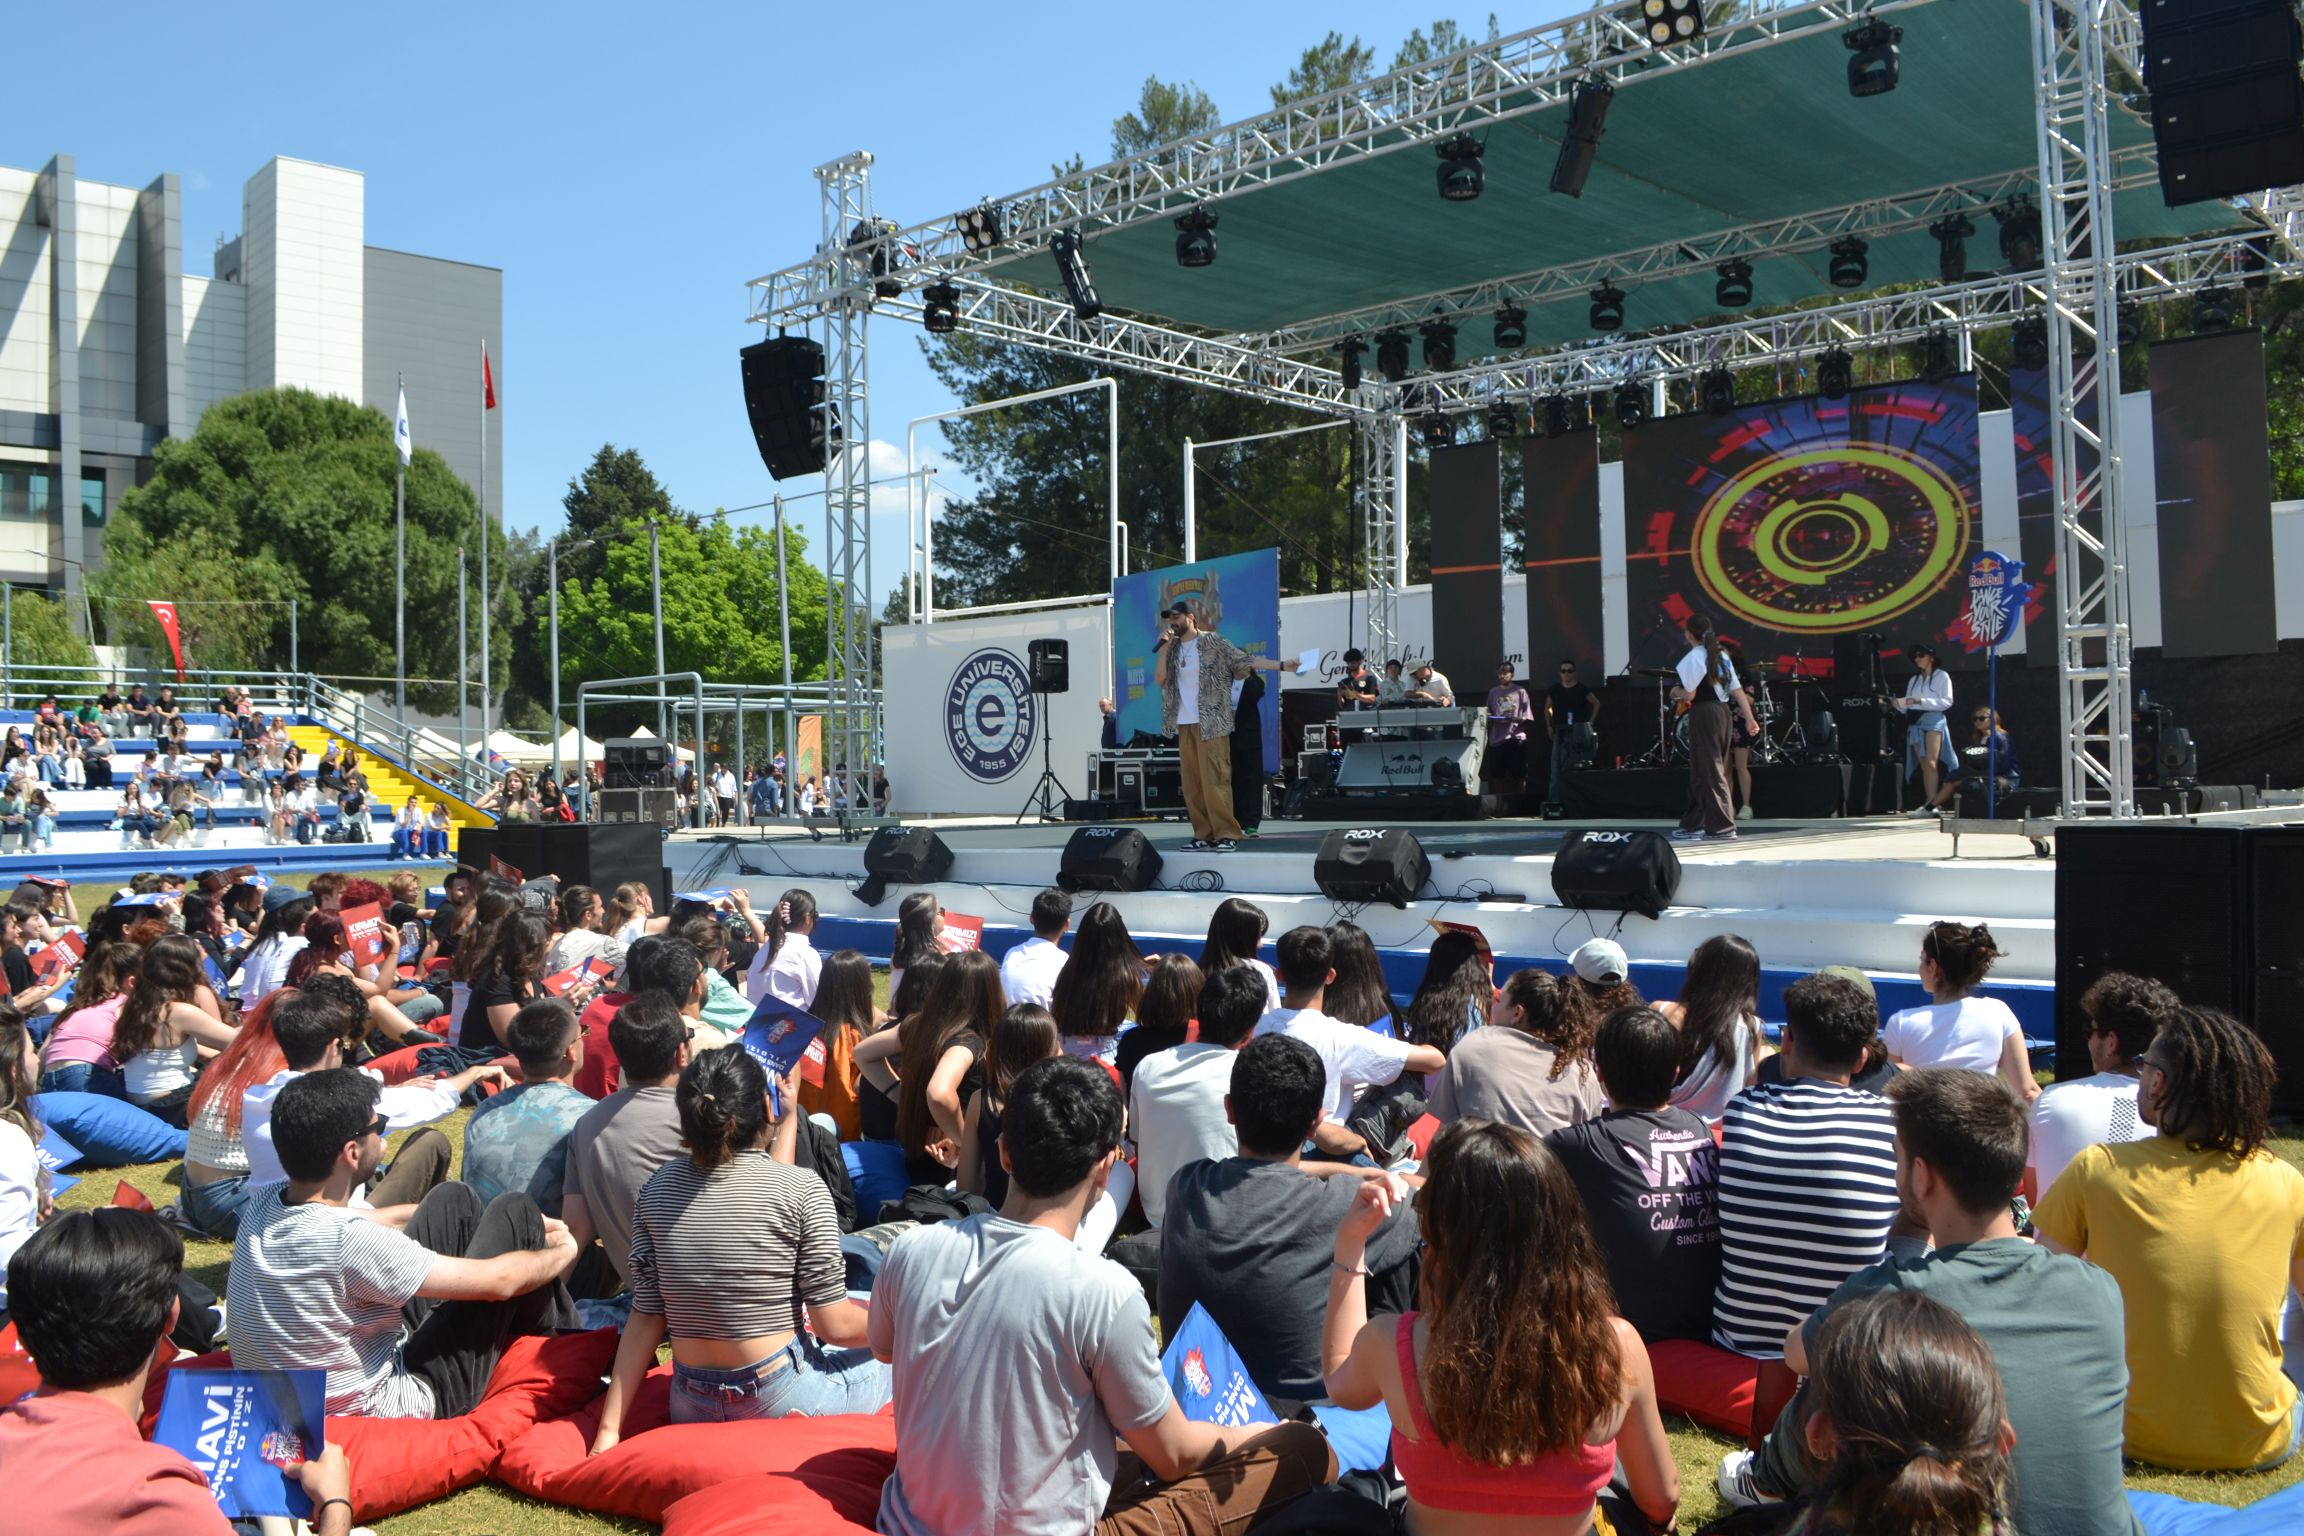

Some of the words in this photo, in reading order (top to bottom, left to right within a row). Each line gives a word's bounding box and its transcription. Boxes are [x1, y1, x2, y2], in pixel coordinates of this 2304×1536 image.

[1842, 698, 1871, 707] ROX
[952, 713, 976, 762] EGE
[980, 759, 1007, 770] 1955
[1085, 828, 1119, 837] ROX
[1344, 829, 1387, 839] ROX
[1582, 831, 1632, 842] ROX
[1623, 1137, 1719, 1187] VANS
[1638, 1193, 1672, 1209] OFF
[1675, 1191, 1703, 1207] THE
[1650, 1211, 1694, 1231] Custom
[1676, 1233, 1704, 1246] SINCE
[1228, 1375, 1244, 1406] DANS
